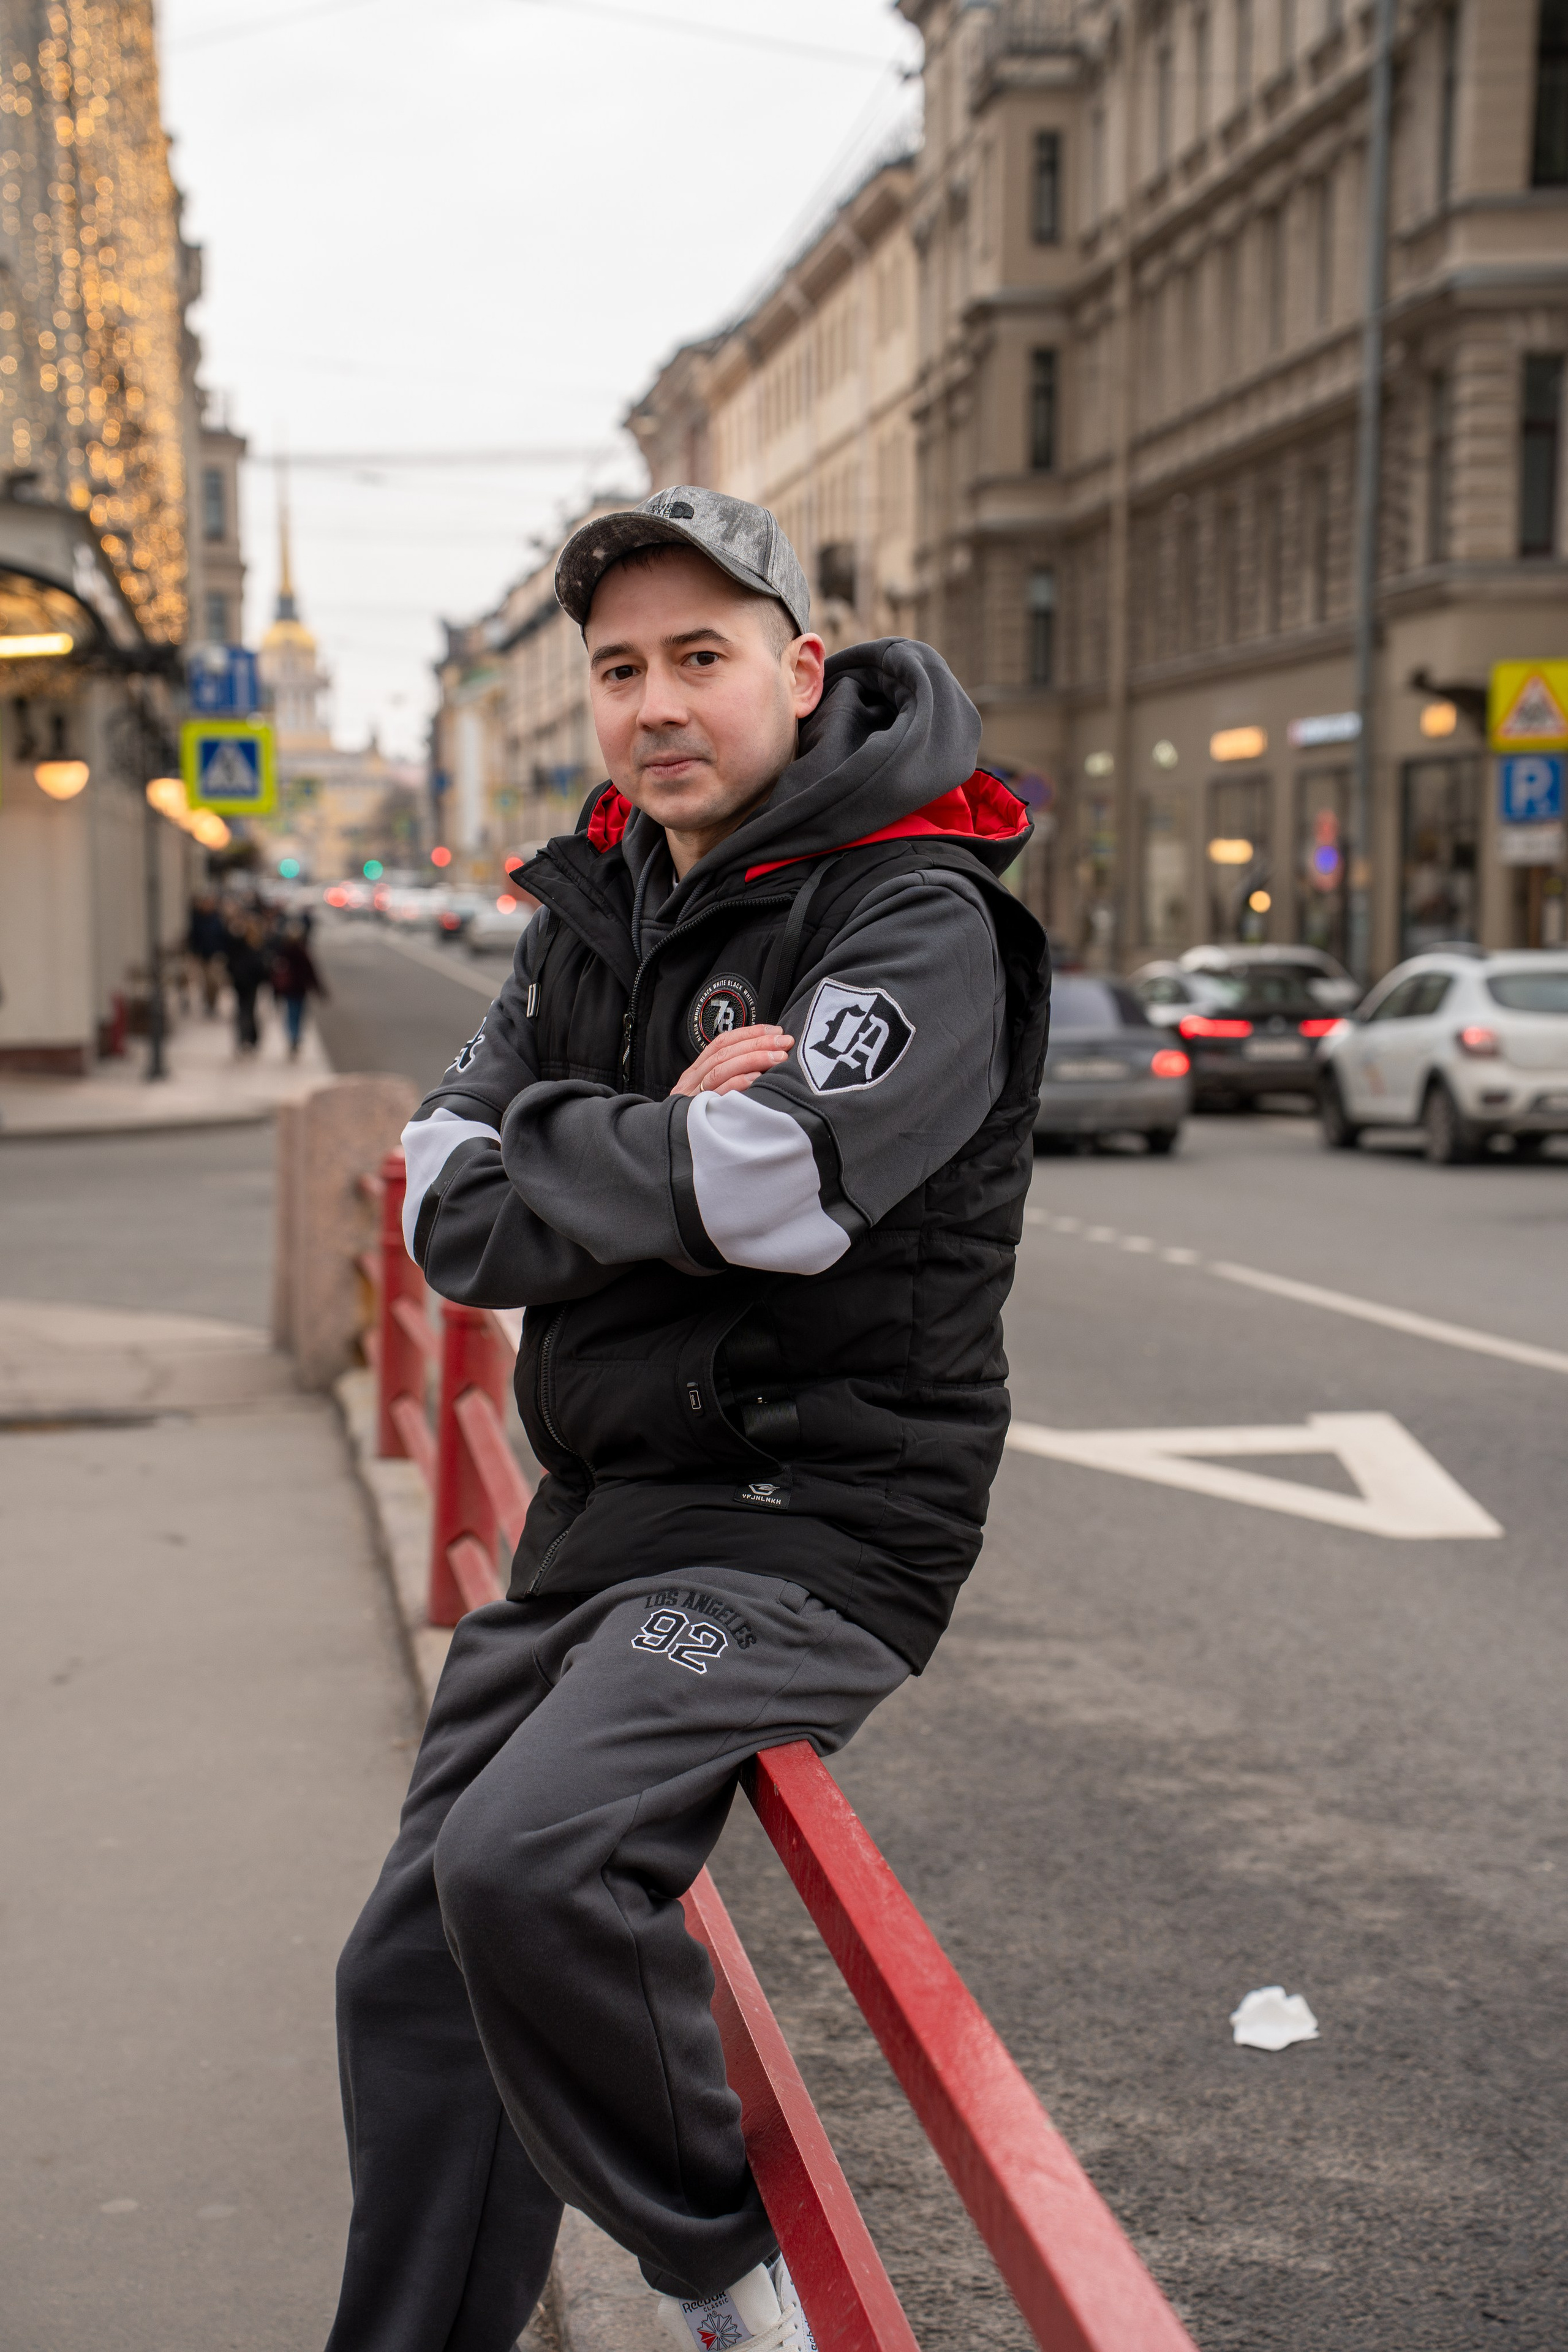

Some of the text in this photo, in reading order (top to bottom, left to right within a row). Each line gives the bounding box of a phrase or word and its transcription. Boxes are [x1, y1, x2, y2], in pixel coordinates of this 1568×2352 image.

[693, 1023, 702, 1041] BLACK
[699, 987, 712, 1003] BLACK
[712, 980, 726, 989] WHITE
[727, 980, 743, 991] BLACK
[743, 989, 754, 1005] WHITE
[742, 1493, 782, 1505] YFJNLNKH
[631, 1608, 728, 1675] 92
[644, 1591, 757, 1650] LOS ANGELES
[703, 2297, 729, 2313] CLASSIC
